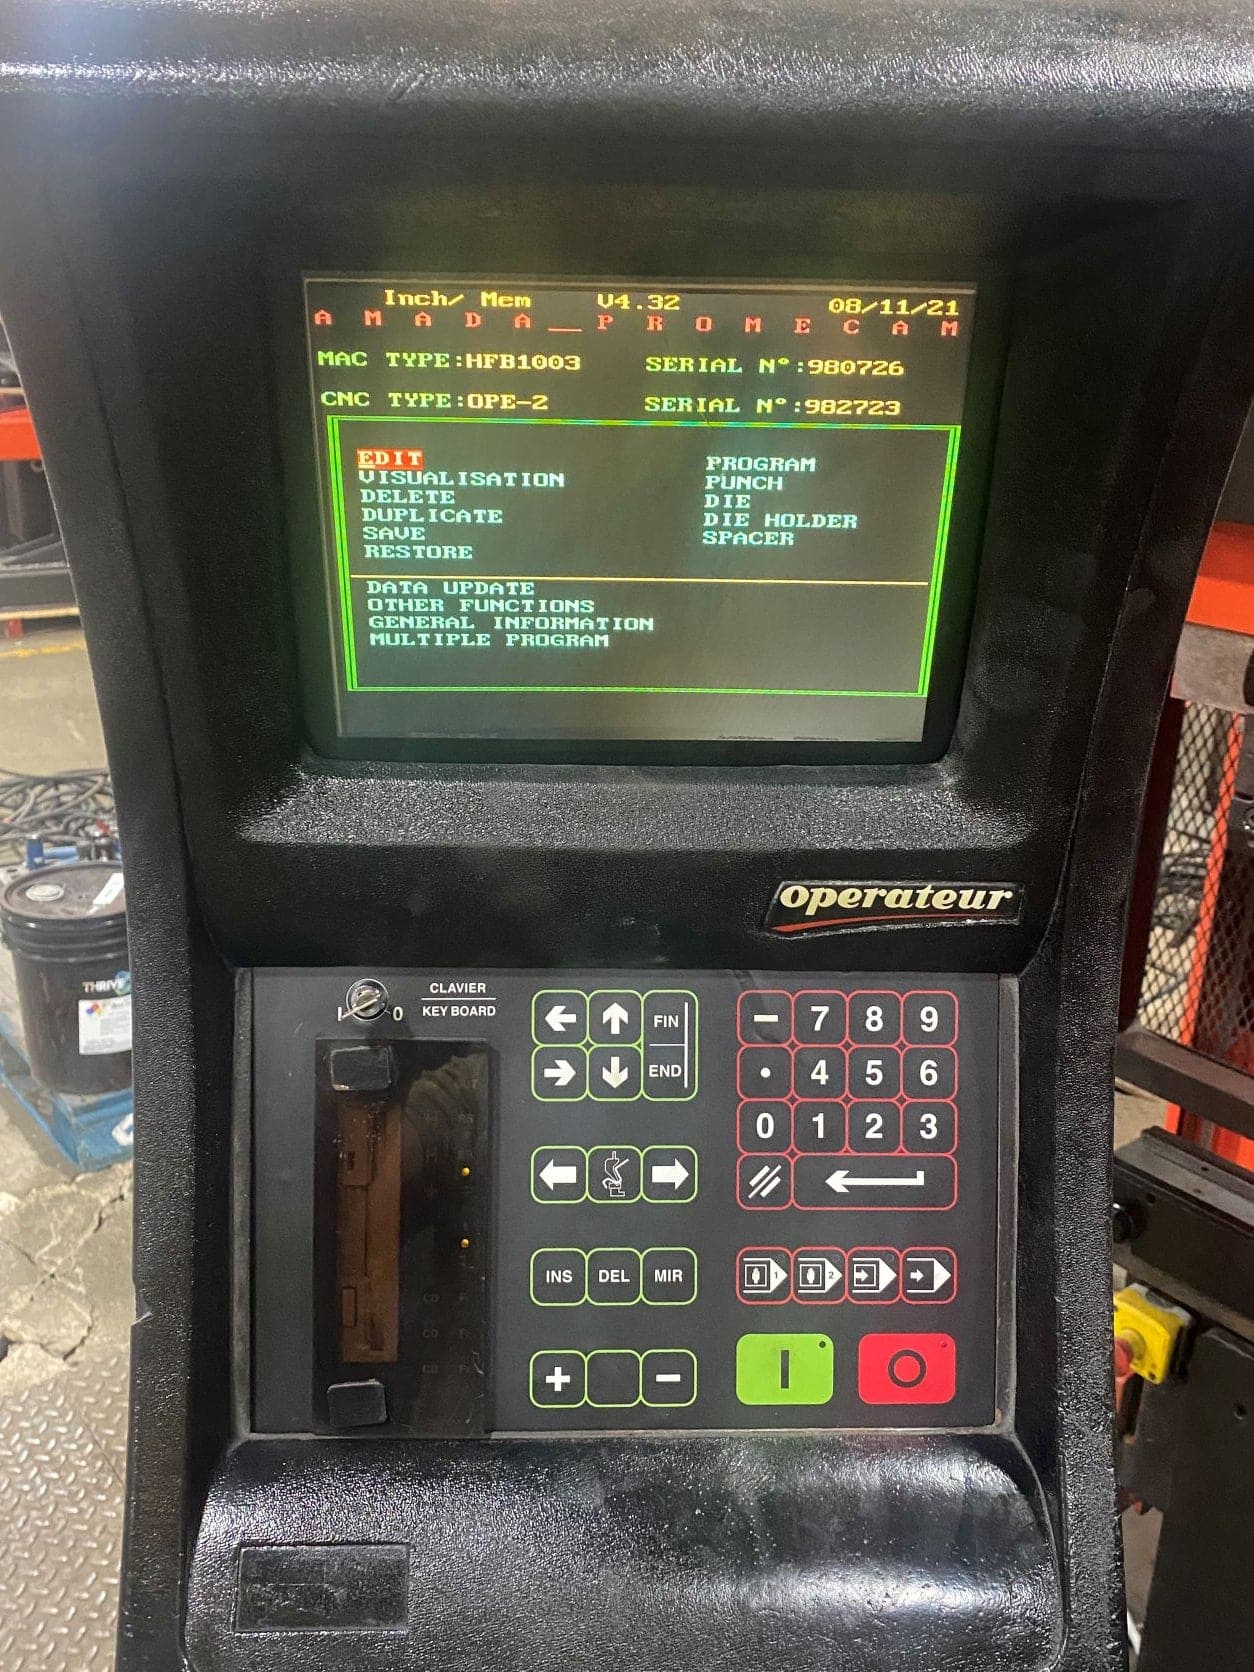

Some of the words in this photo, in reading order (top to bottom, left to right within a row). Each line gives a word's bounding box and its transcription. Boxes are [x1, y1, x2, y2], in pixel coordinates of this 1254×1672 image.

[384, 289, 465, 307] Inch/
[481, 291, 531, 308] Mem
[597, 293, 680, 311] V4.32
[828, 298, 959, 316] 08/11/21
[318, 351, 367, 367] MAC
[645, 357, 742, 374] SERIAL
[321, 391, 370, 407] CNC
[644, 397, 740, 413] SERIAL
[358, 451, 423, 467] EDIT
[705, 456, 816, 472] PROGRAM
[358, 470, 565, 488] VISUALISATION
[704, 475, 783, 491] PUNCH
[360, 489, 455, 504] DELETE
[704, 494, 750, 509] DIE
[362, 508, 503, 524] DUPLICATE
[703, 512, 750, 528] DIE
[764, 513, 858, 529] HOLDER
[362, 527, 425, 541] SAVE
[702, 531, 794, 546] SPACER
[364, 545, 473, 559] RESTORE
[366, 581, 428, 595] DATA
[443, 581, 535, 596] UPDATE
[368, 599, 444, 612] OTHER
[459, 600, 595, 613] FUNCTIONS
[369, 616, 475, 630] GENERAL
[494, 617, 654, 631] INFORMATION
[370, 633, 491, 646] MULTIPLE
[505, 634, 609, 647] PROGRAM
[429, 982, 486, 994] CLAVIER
[653, 1015, 679, 1028] FIN
[811, 1005, 829, 1031] 7
[865, 1005, 883, 1032] 8
[920, 1006, 938, 1032] 9
[649, 1064, 682, 1078] END
[811, 1059, 829, 1085] 4
[865, 1060, 883, 1085] 5
[919, 1060, 938, 1086] 6
[756, 1112, 774, 1138] 0
[812, 1112, 825, 1138] 1
[865, 1113, 883, 1138] 2
[919, 1113, 938, 1139] 3
[546, 1269, 573, 1283] INS
[598, 1269, 631, 1283] DEL
[654, 1269, 683, 1282] MIR
